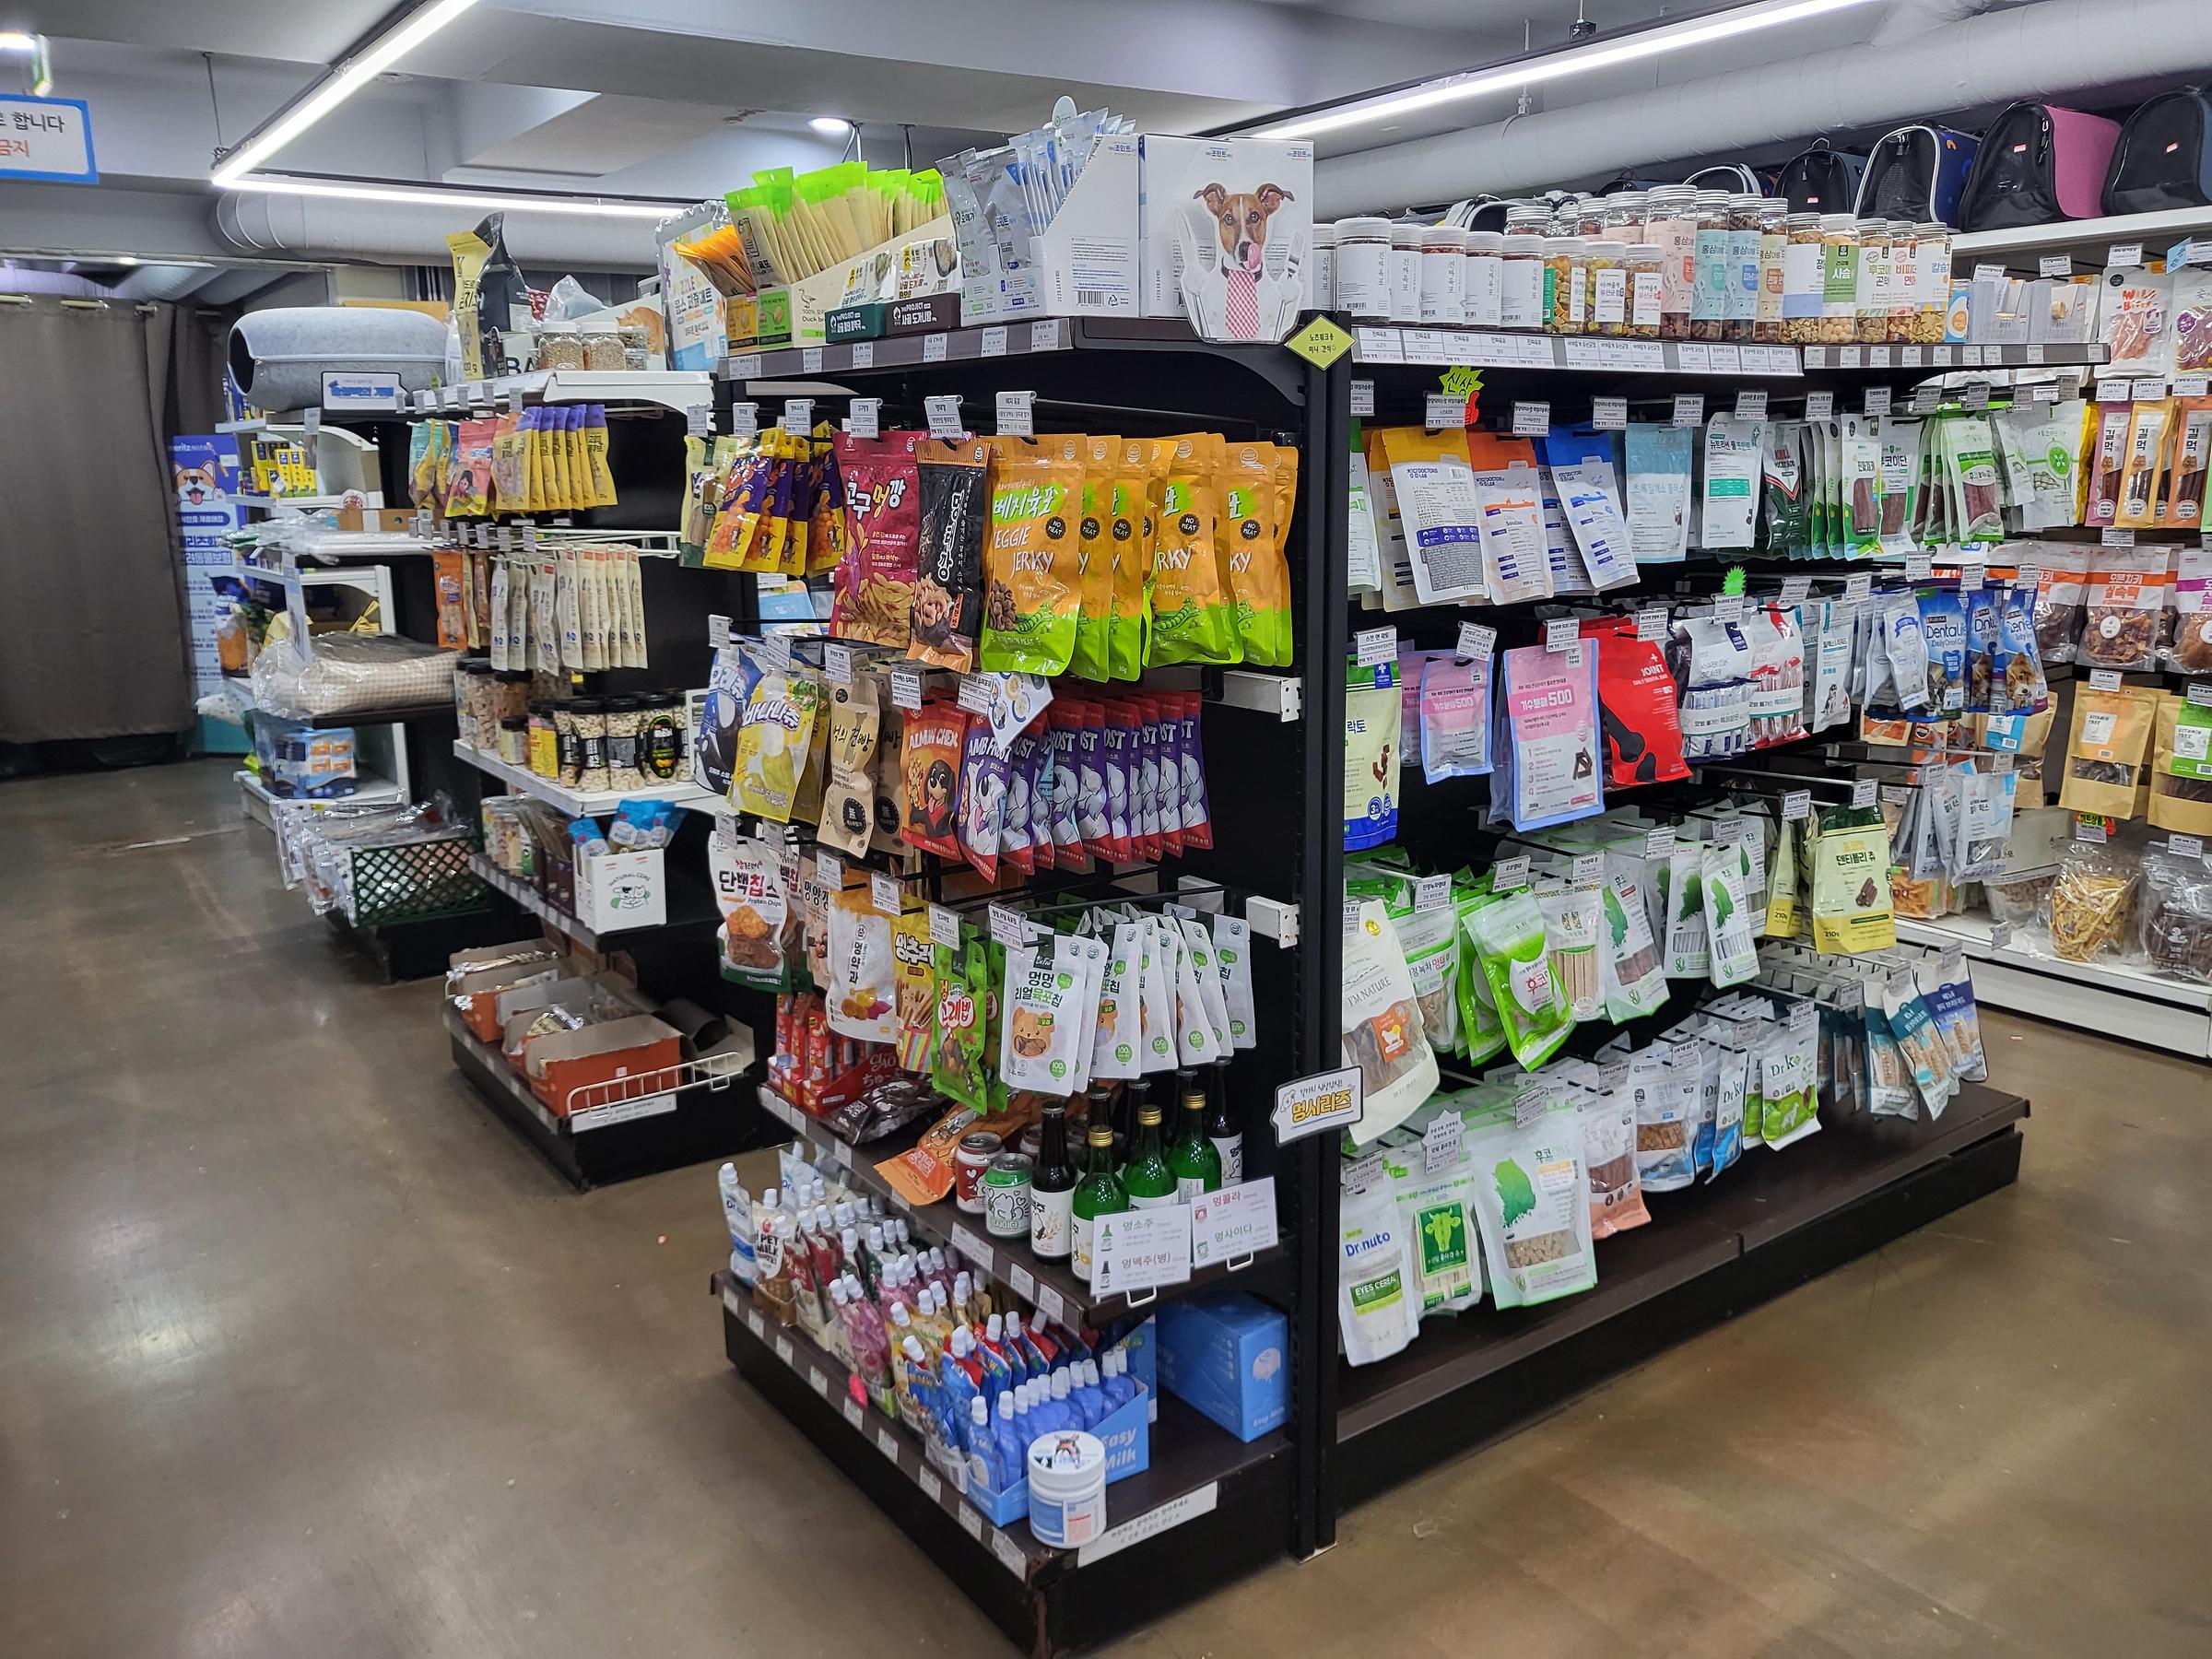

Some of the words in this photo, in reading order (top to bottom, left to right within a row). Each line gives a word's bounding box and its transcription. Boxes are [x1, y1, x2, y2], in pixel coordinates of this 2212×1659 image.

[12, 112, 65, 133] 합니다
[1447, 372, 1473, 395] 신상
[846, 479, 906, 521] 고구멍깡
[1010, 551, 1055, 579] JERKY
[1641, 664, 1665, 677] JOINT
[742, 700, 801, 731] 바나나츄
[719, 871, 781, 899] 단백칩스
[1028, 971, 1054, 988] 멍멍
[1015, 987, 1064, 1008] 리얼육포칩
[1347, 991, 1361, 1007] I'M
[1361, 976, 1392, 1001] NATURE
[941, 997, 971, 1022] 고래밥
[1291, 1089, 1353, 1123] 멍시리즈
[1535, 1147, 1553, 1163] 후코
[1213, 1190, 1241, 1206] 멍콜라
[1123, 1218, 1154, 1231] 멍소주
[1214, 1224, 1253, 1242] 멍사이다
[760, 1234, 779, 1244] PET
[1122, 1252, 1171, 1269] 멍맥주(병)
[1355, 1283, 1374, 1297] EYES
[1374, 1277, 1397, 1291] CEREAL
